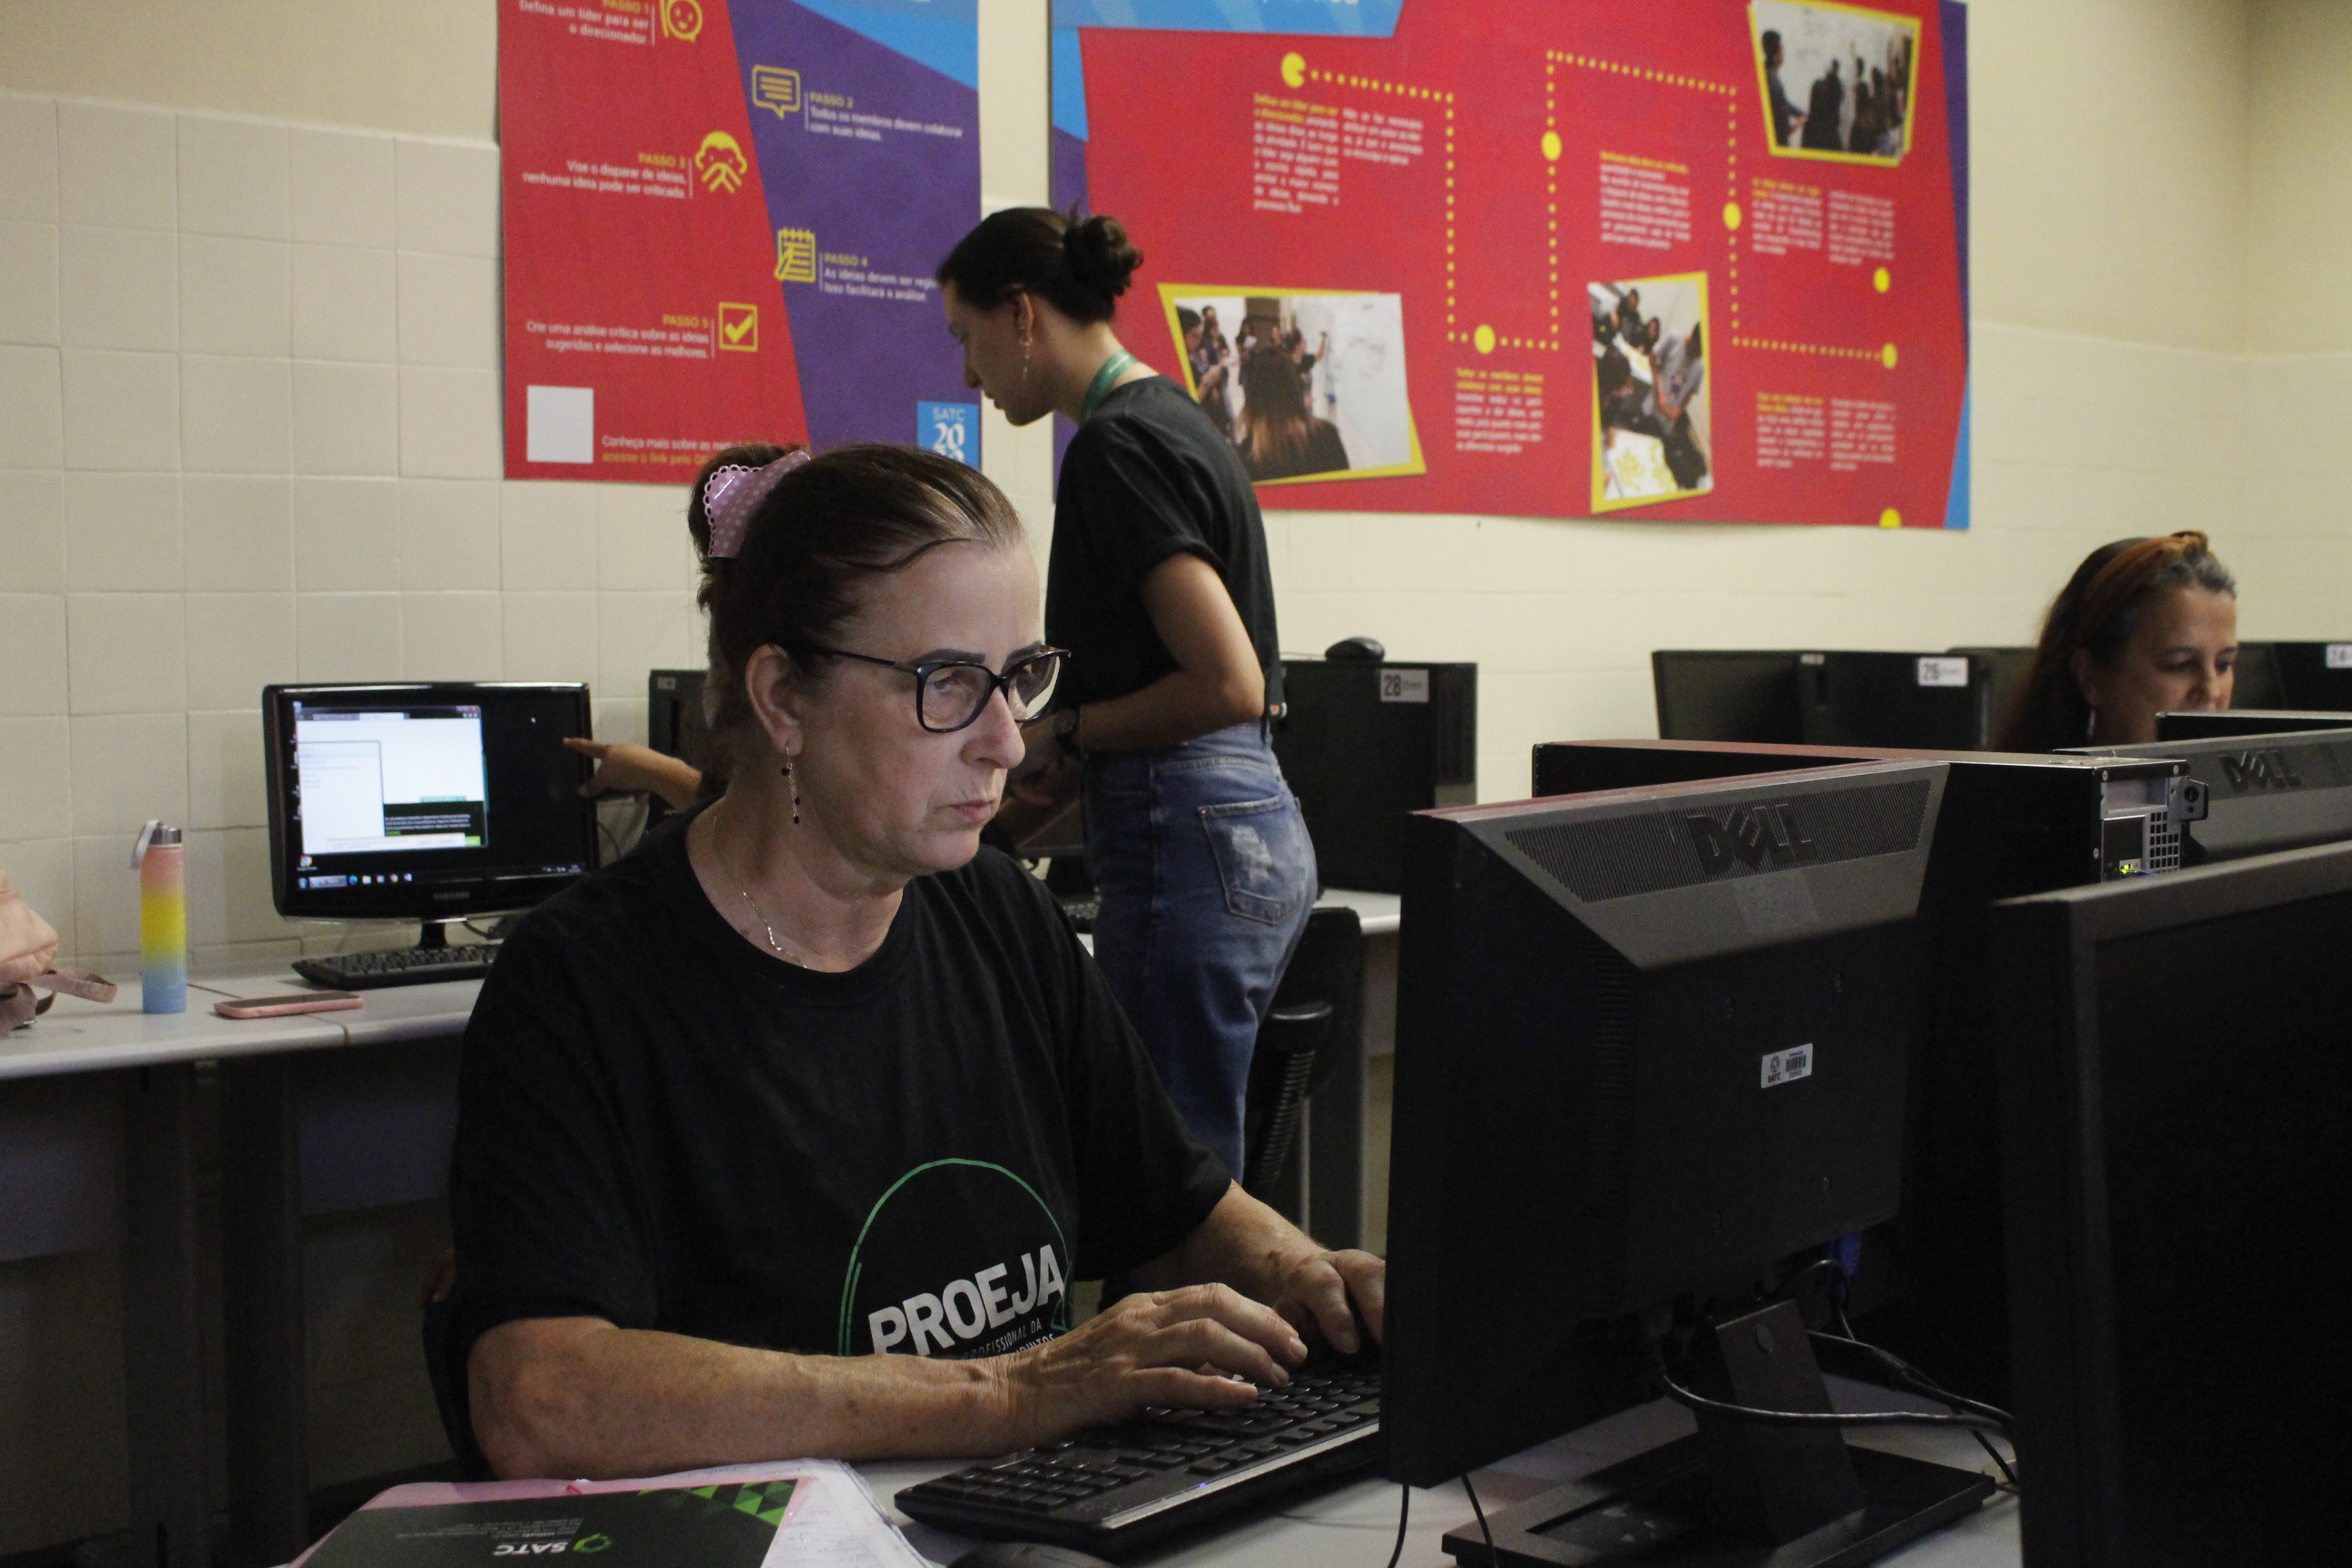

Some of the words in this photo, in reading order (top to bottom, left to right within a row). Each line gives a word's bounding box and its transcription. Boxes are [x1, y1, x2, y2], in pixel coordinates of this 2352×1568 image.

[557, 6, 575, 18] um
[604, 14, 630, 27] para
[933, 407, 965, 422] SATC
[1383, 673, 1402, 697] 28
[2219, 750, 2302, 793] DELL
[1686, 802, 1818, 878] DELL
[868, 1244, 1064, 1357] PROEJA
[963, 1325, 1027, 1360] PROFISSIONAL
[1030, 1318, 1043, 1335] DA
[493, 1542, 569, 1557] SATC
